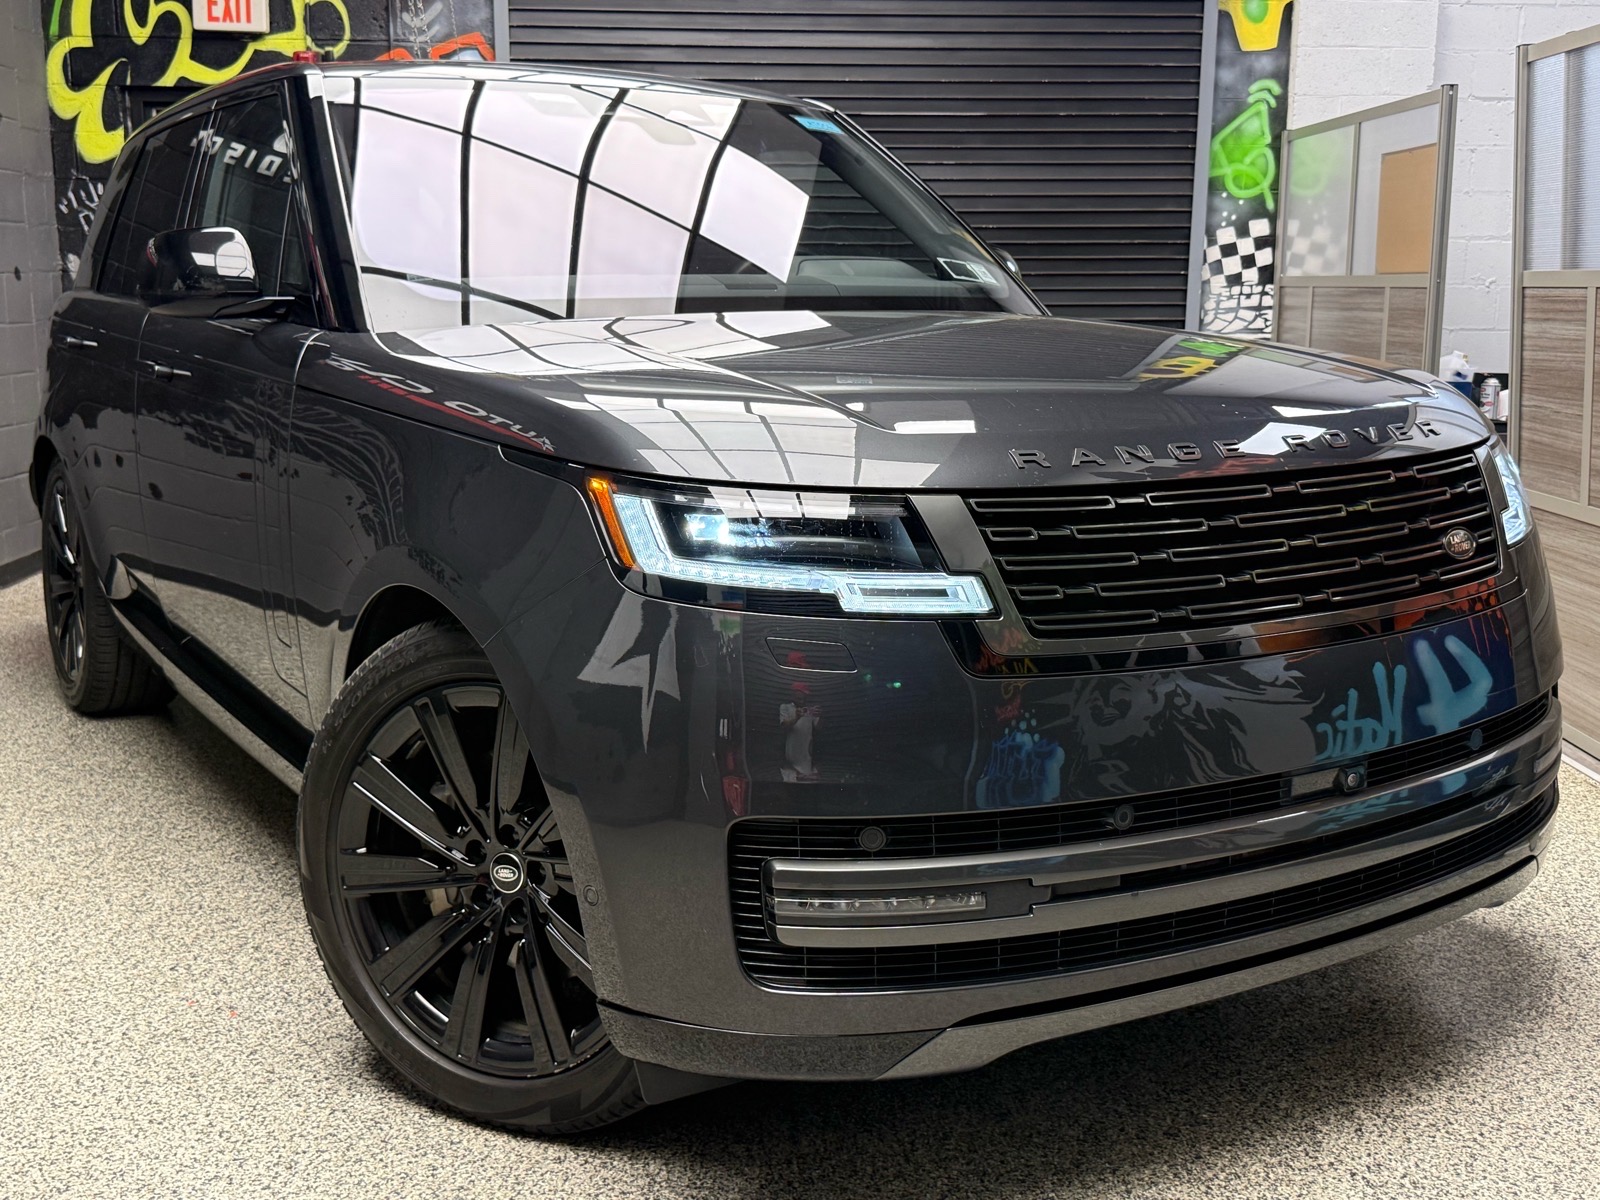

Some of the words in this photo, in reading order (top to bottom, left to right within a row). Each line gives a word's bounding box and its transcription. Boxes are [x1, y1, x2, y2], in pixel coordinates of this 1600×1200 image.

[207, 0, 252, 24] EXIT
[1008, 438, 1246, 470] RANGE
[1282, 419, 1442, 454] ROVER
